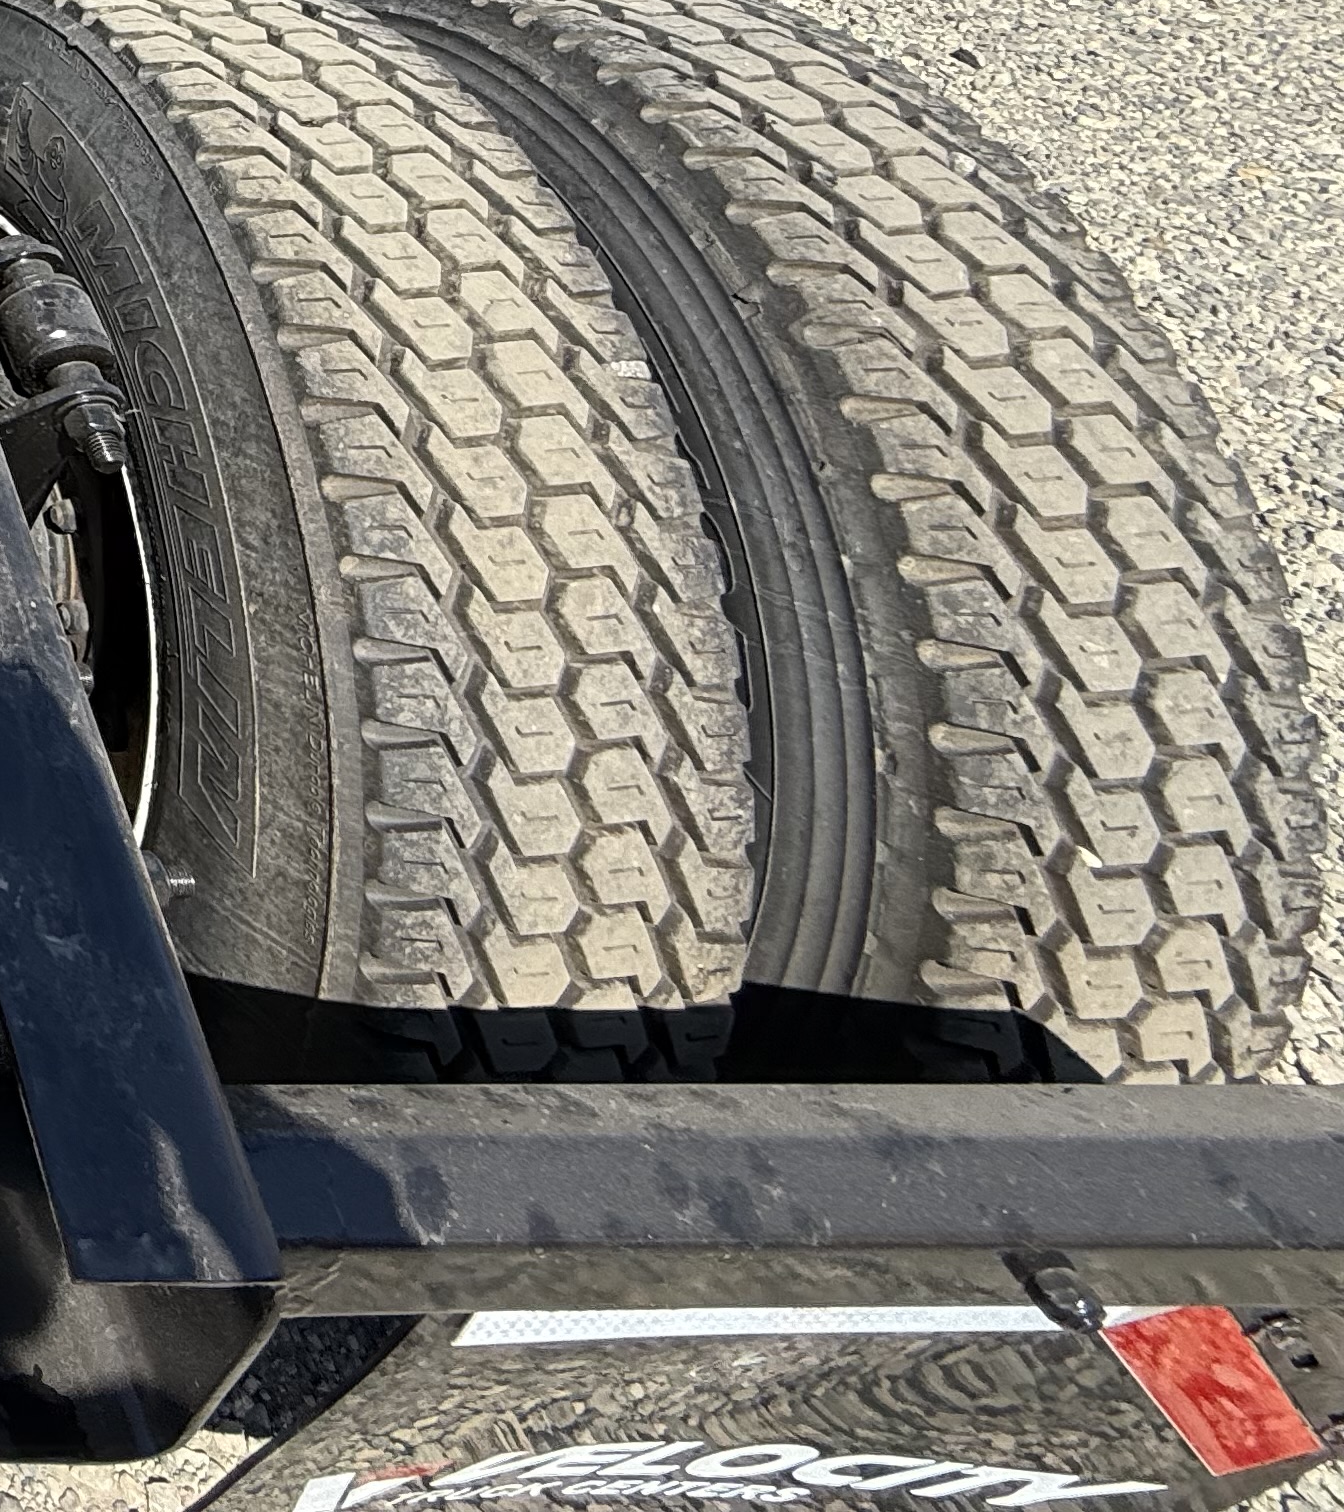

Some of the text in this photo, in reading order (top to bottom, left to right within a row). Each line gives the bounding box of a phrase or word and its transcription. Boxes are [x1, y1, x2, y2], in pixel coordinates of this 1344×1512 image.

[73, 197, 245, 849] MICHELIN
[384, 1479, 812, 1507] TRUCK CENTERS
[429, 1440, 1170, 1507] VELOCITY
